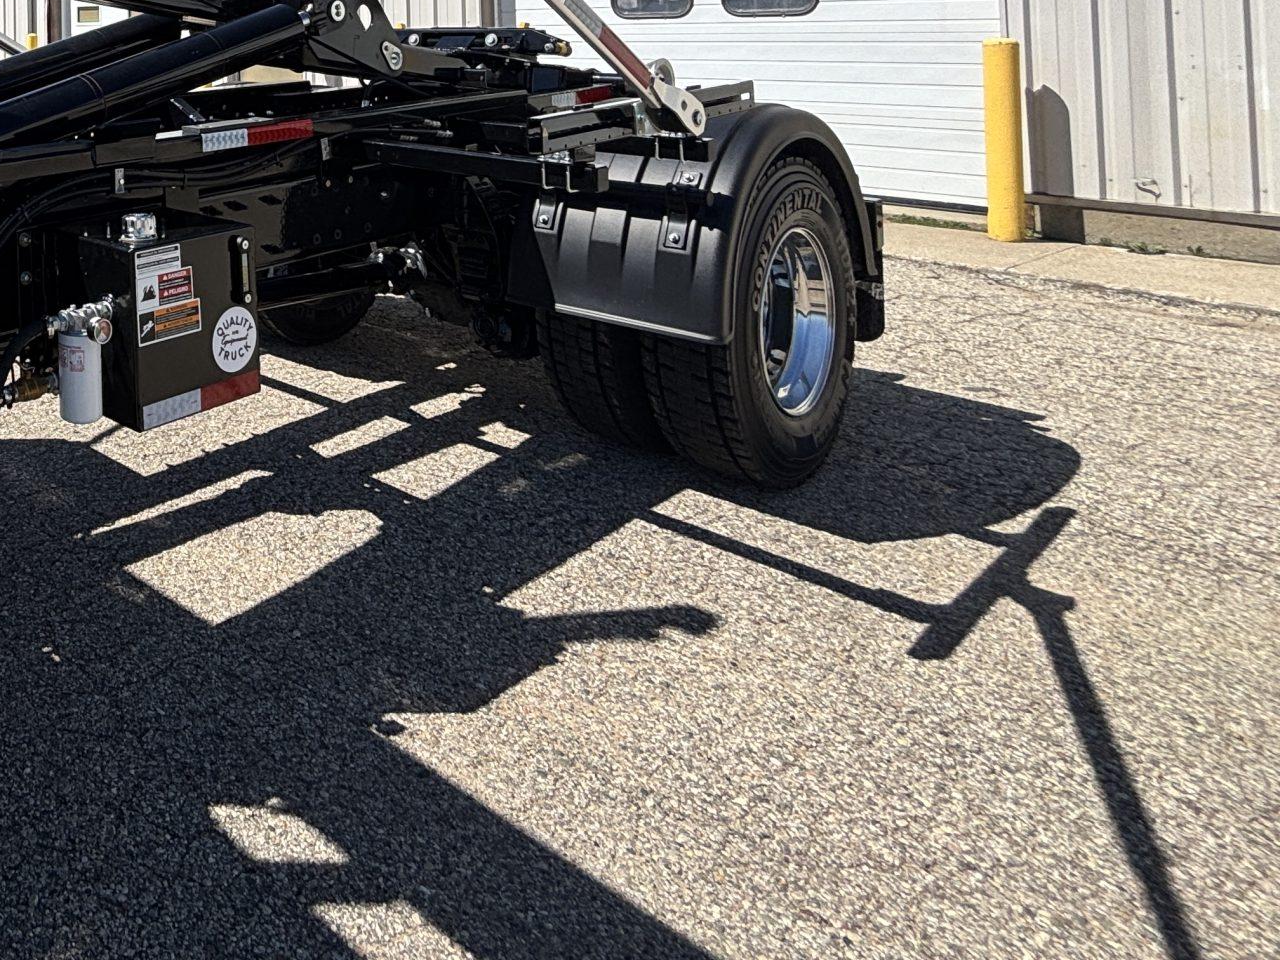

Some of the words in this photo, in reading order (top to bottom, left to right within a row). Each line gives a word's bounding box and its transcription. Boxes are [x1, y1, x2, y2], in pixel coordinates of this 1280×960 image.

[752, 187, 822, 312] CONTINENTAL
[216, 315, 254, 337] QUALITY
[218, 341, 252, 360] TRUCK
